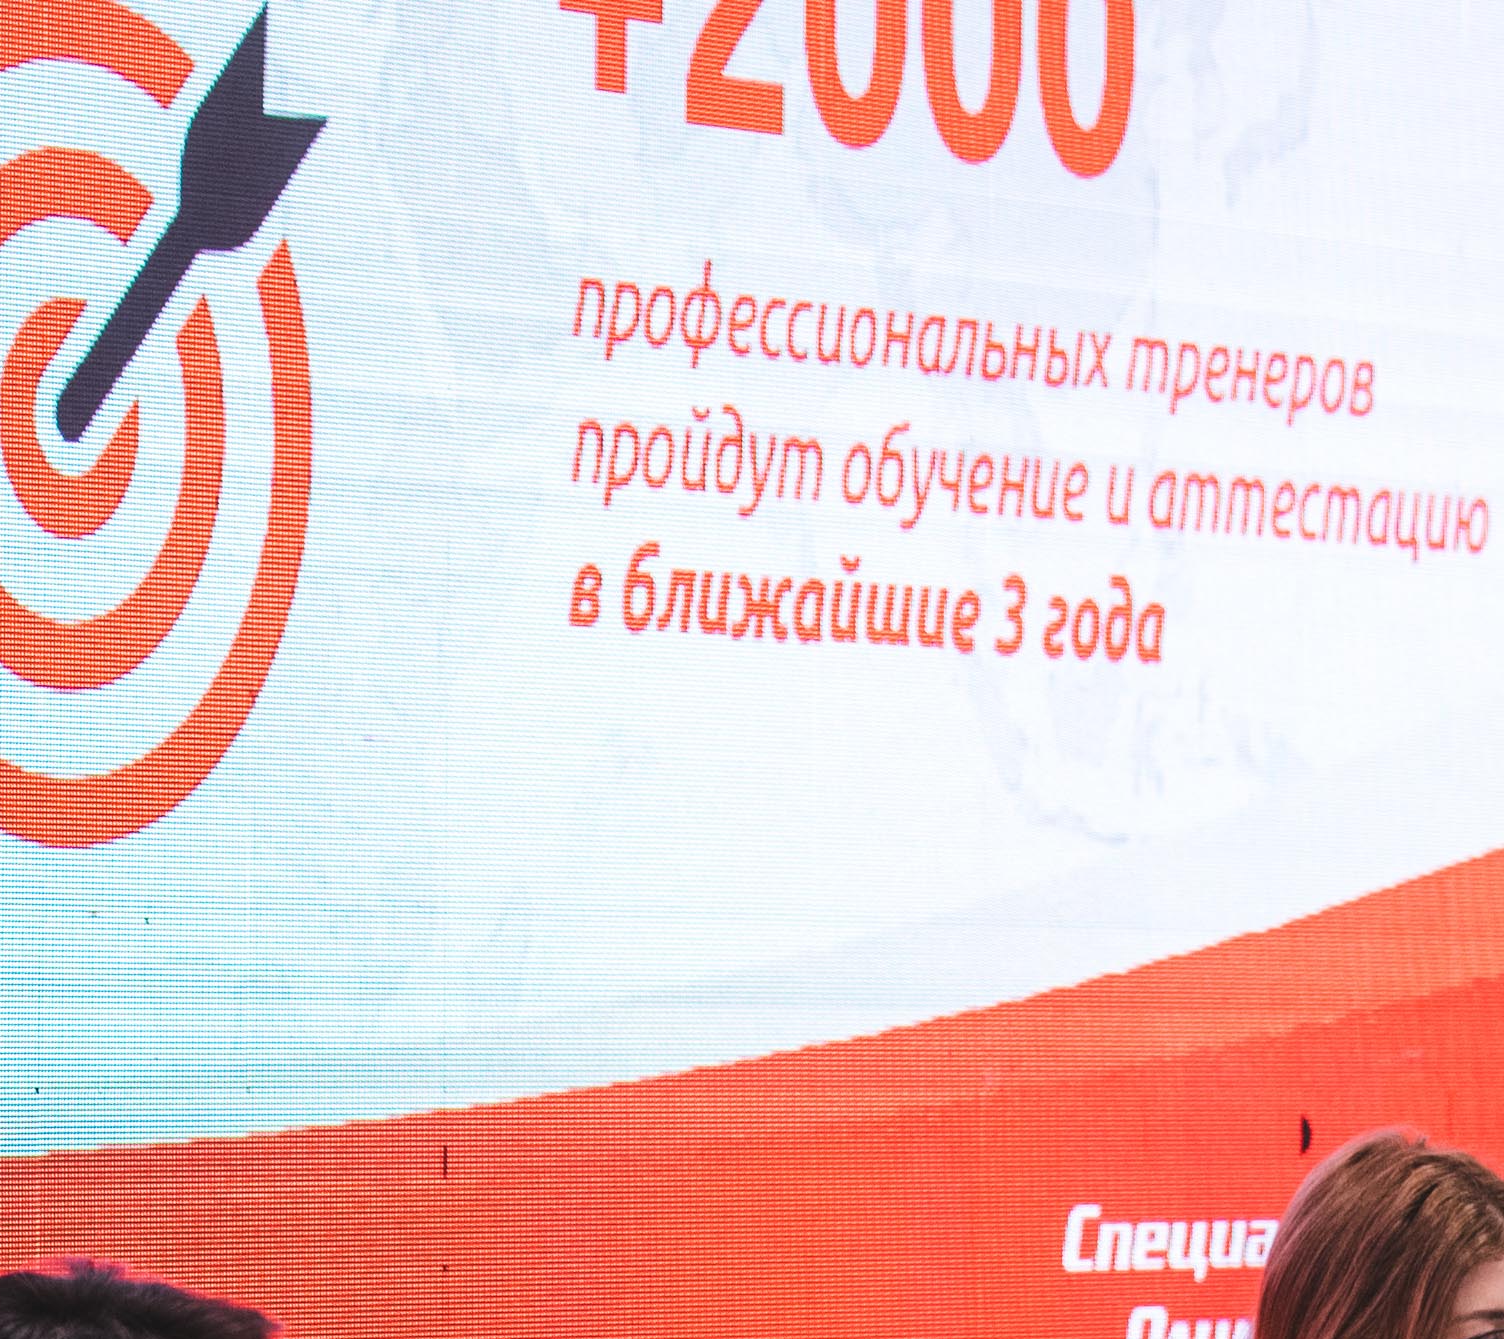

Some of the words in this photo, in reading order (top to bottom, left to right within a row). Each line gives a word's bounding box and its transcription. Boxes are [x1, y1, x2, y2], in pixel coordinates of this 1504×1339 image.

[572, 258, 1113, 388] профессиональных
[1126, 336, 1375, 427] тренеров
[572, 404, 824, 518] пройдут
[842, 421, 1090, 530] обучение
[1106, 463, 1135, 526] и
[1148, 469, 1491, 562] аттестацию
[568, 562, 604, 628] в
[623, 541, 981, 654] ближайшие
[994, 574, 1029, 657] 3
[1043, 575, 1166, 664] года
